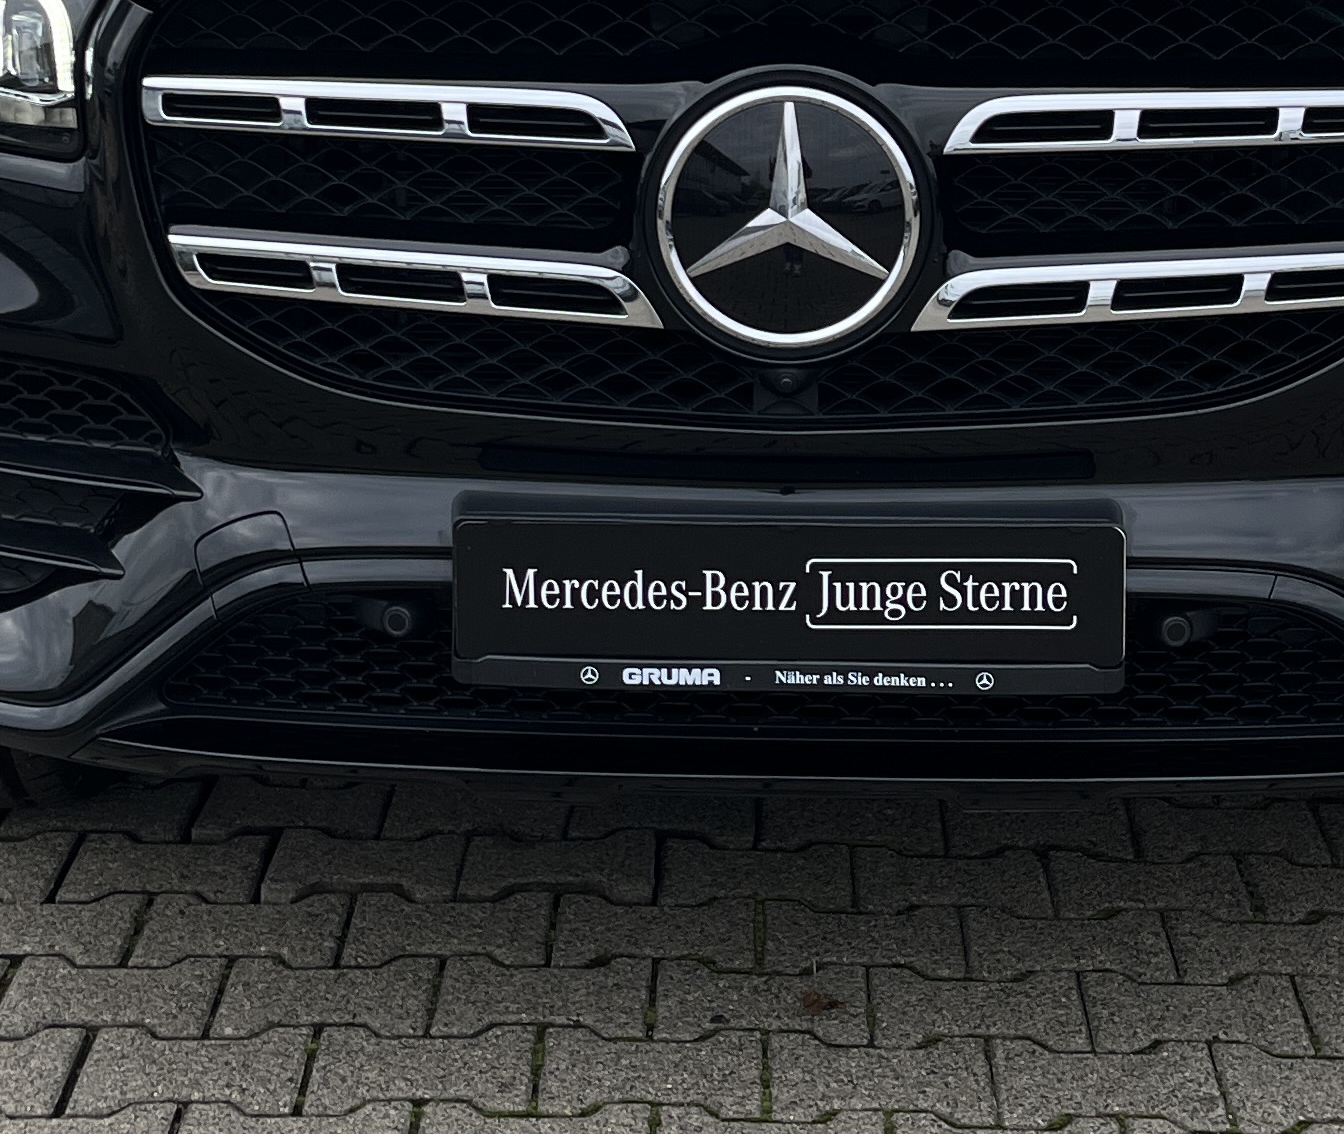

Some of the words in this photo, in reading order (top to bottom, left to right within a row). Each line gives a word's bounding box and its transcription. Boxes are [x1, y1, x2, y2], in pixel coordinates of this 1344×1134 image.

[501, 567, 797, 611] Mercedes-Benz
[815, 570, 927, 621] Junge
[939, 569, 1068, 612] Sterne
[621, 667, 721, 686] GRUMA
[774, 670, 820, 685] Näher
[823, 671, 844, 686] als
[847, 671, 870, 686] Sie
[873, 672, 926, 688] denken
